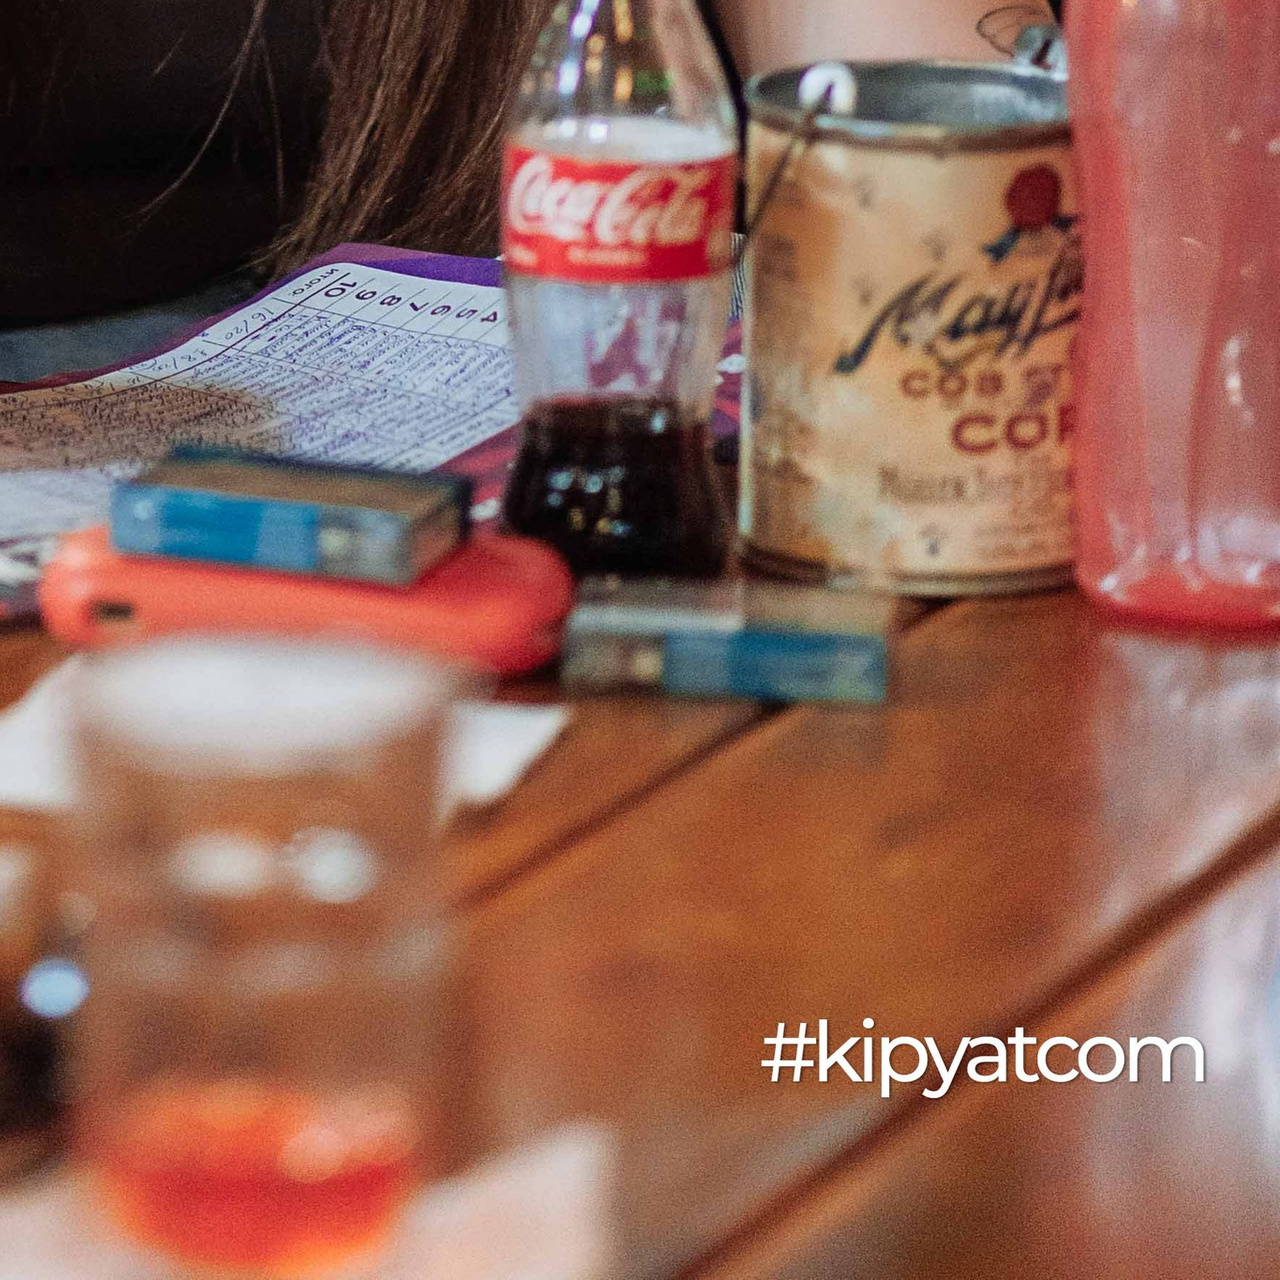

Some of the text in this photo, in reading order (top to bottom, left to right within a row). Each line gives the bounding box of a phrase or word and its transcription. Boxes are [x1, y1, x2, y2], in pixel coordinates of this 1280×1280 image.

[324, 281, 358, 299] 10
[355, 289, 377, 301] 9
[379, 294, 402, 307] 8
[409, 301, 430, 312] 7
[430, 304, 452, 316] 6
[455, 307, 478, 320] 5
[480, 311, 498, 324] 4
